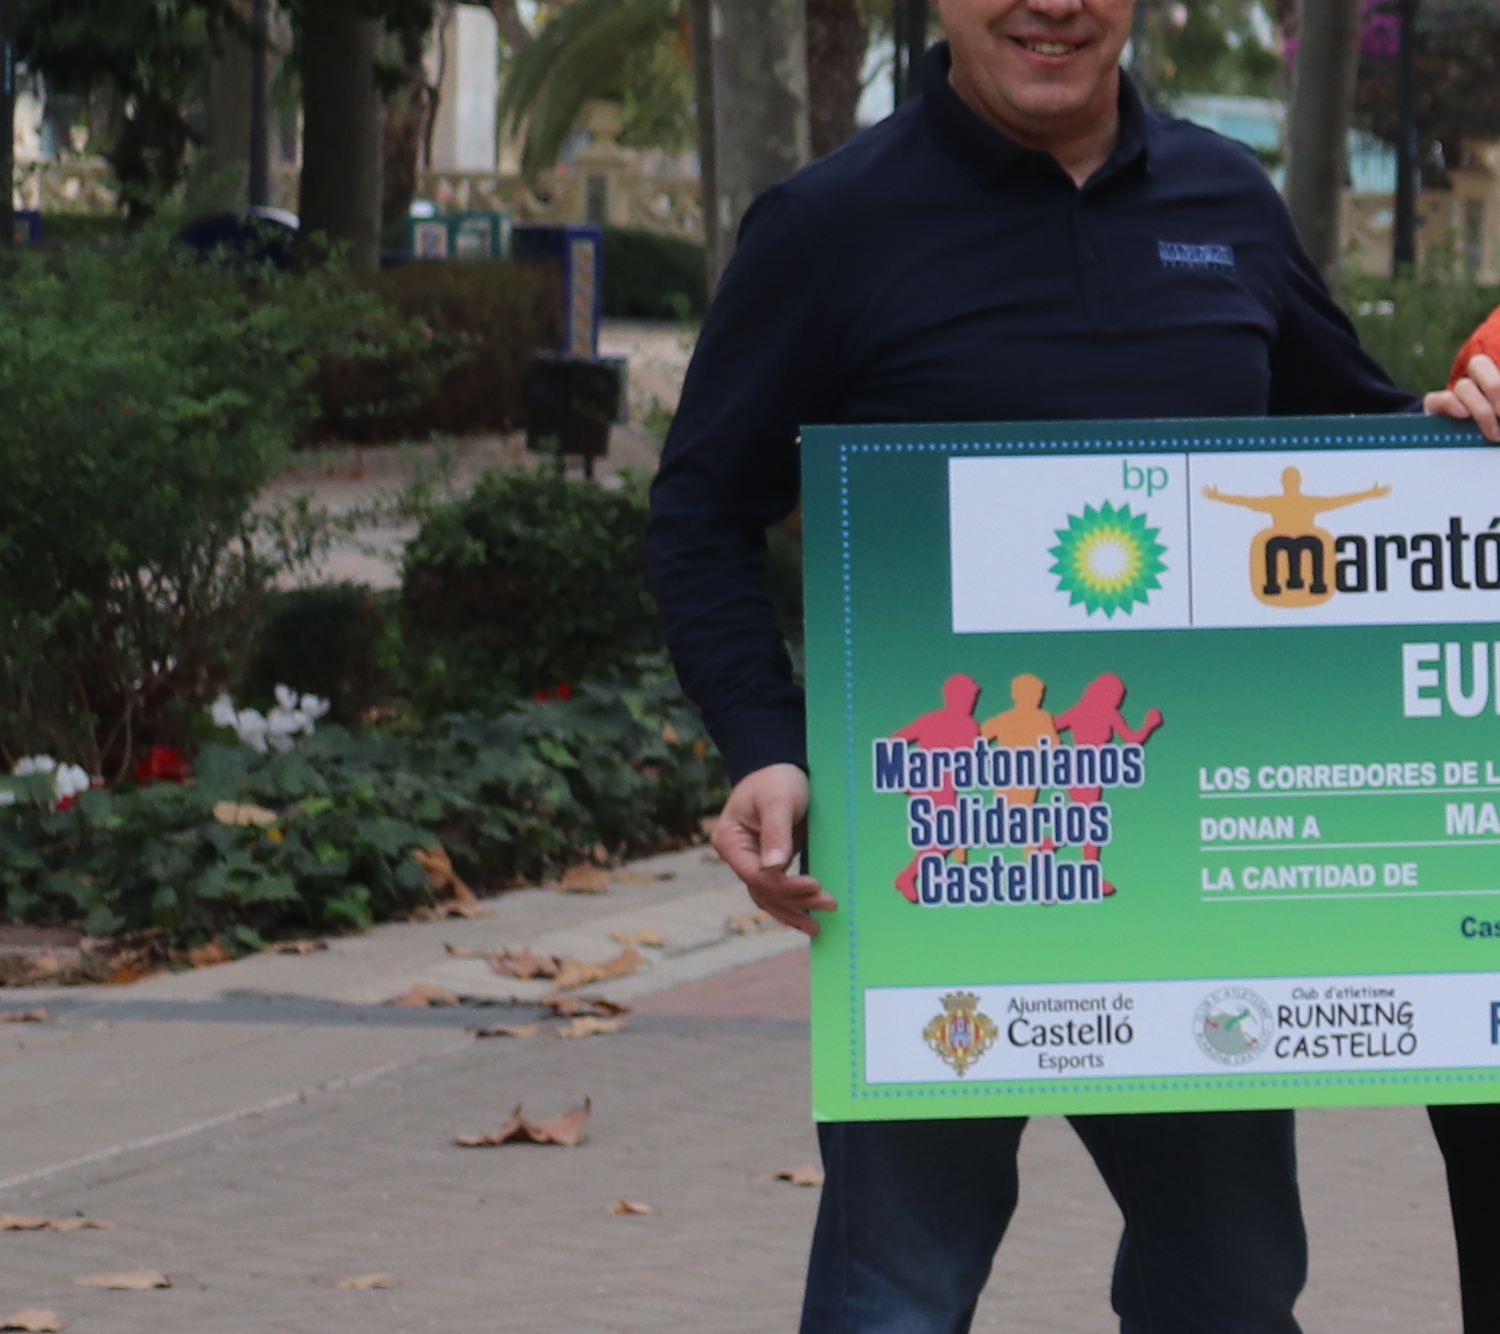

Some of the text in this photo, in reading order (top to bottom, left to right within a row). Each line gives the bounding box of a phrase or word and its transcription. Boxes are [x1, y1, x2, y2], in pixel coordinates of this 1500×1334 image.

[1122, 459, 1169, 497] bp
[875, 737, 1143, 790] Maratonianos
[1199, 766, 1250, 791] LOS
[1258, 762, 1437, 789] CORREDORES
[1444, 761, 1478, 785] DE
[910, 795, 1109, 847] Solidarios
[1200, 816, 1294, 841] DONAN
[1302, 815, 1321, 839] A
[920, 853, 1102, 905] Castellon
[1201, 867, 1235, 891] LA
[1241, 864, 1376, 890] CANTIDAD
[1383, 863, 1418, 886] DE
[1007, 994, 1134, 1019] Ajuntament de
[1277, 1002, 1414, 1029] RUNNING
[1007, 1015, 1134, 1047] Castelló
[1274, 1028, 1417, 1059] CASTELLÓ
[1038, 1052, 1104, 1073] Esports
